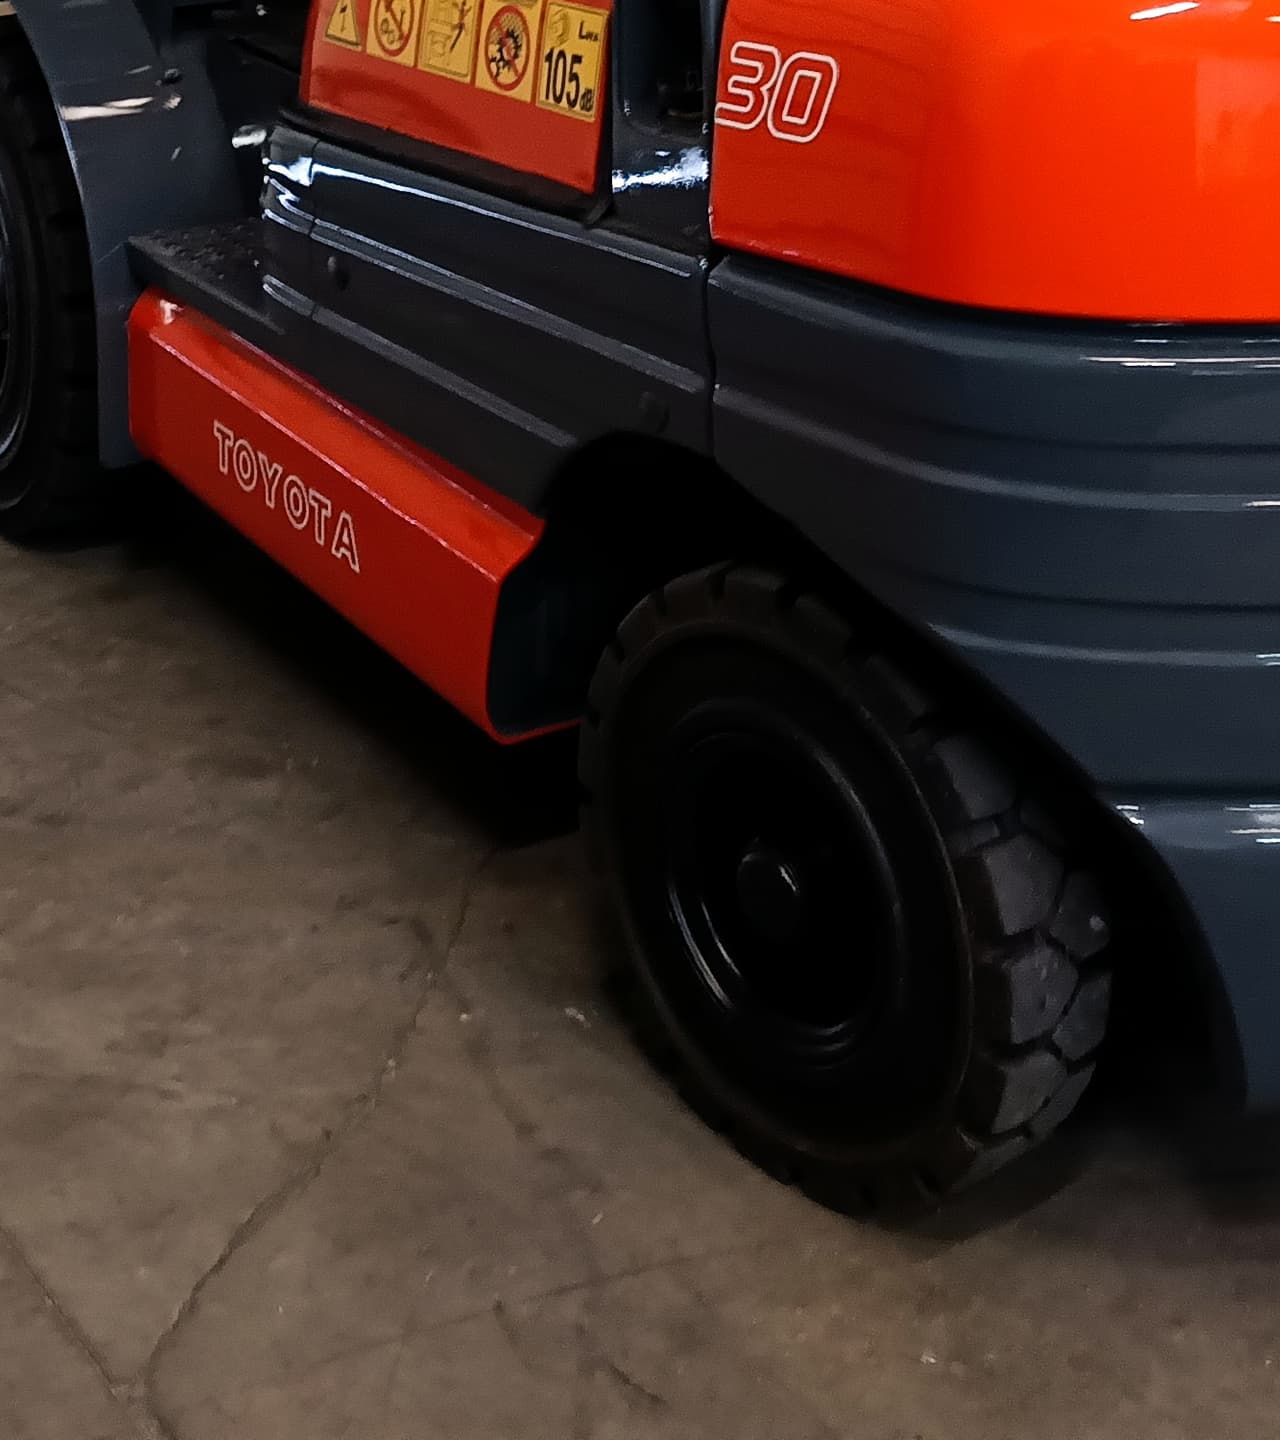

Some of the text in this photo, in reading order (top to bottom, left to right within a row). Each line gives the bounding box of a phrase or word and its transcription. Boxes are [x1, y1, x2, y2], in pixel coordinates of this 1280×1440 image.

[544, 47, 583, 109] 105
[715, 41, 840, 143] 30
[213, 419, 361, 574] TOYOTA
